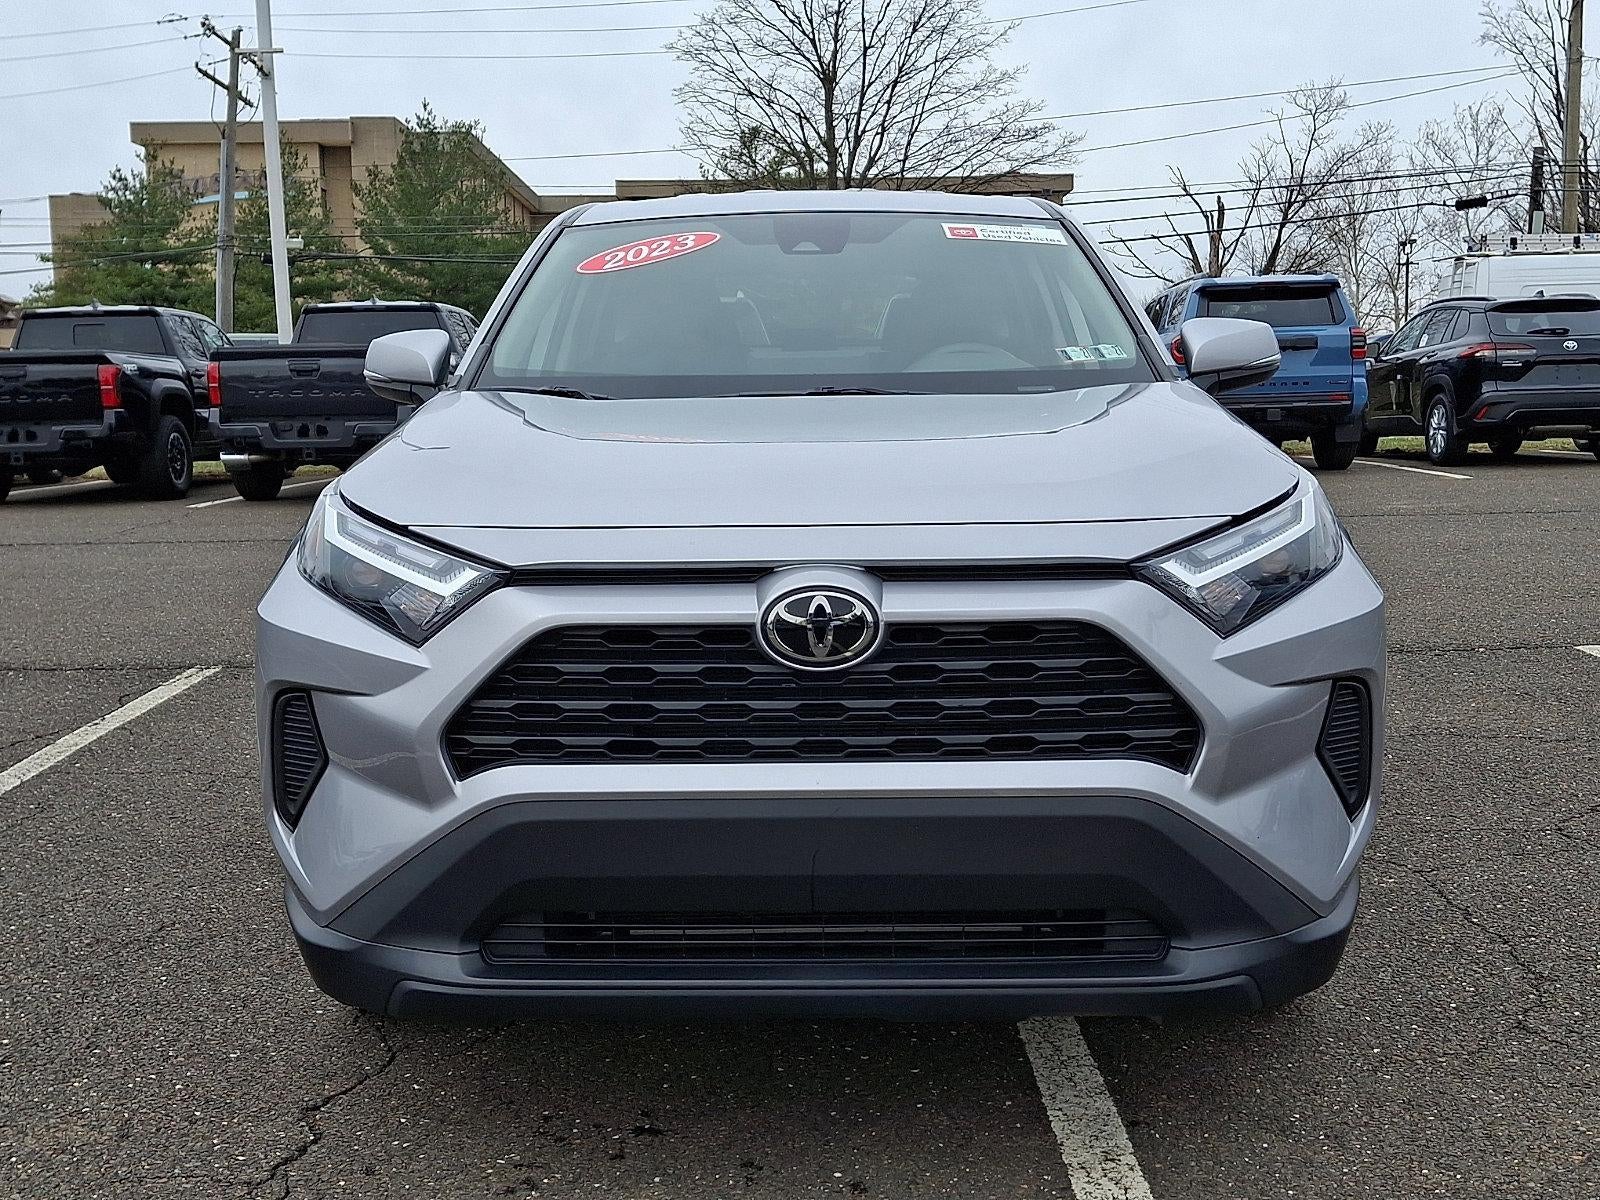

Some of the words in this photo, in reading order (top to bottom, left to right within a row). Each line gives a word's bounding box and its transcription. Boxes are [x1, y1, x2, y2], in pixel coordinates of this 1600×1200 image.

[980, 228, 1031, 236] Certified
[1014, 235, 1062, 243] Vehicles
[602, 234, 696, 270] 2023
[248, 389, 366, 398] TACOMA
